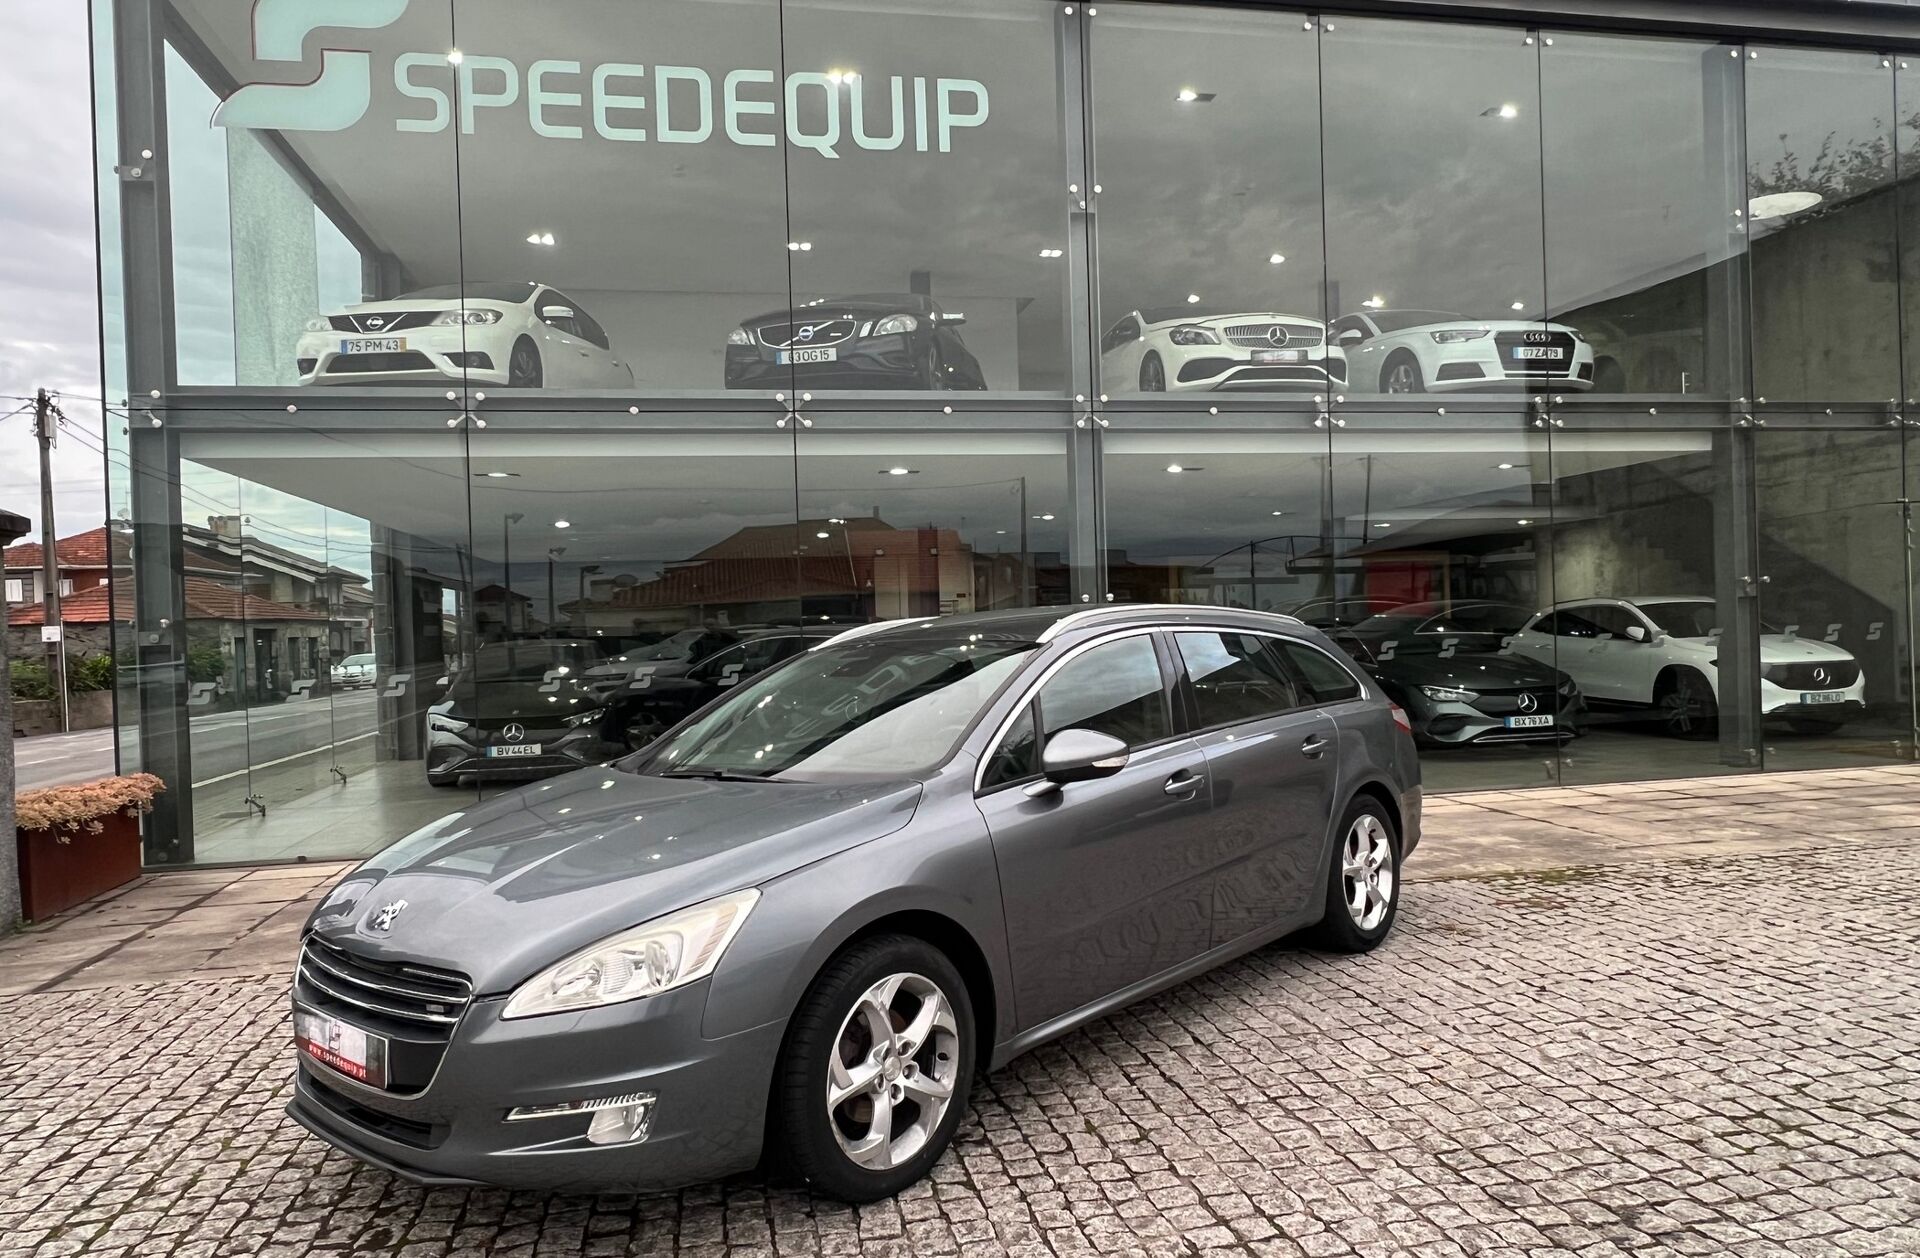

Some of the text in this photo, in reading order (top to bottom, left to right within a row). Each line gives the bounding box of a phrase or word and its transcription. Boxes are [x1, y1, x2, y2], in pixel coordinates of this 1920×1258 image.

[393, 51, 990, 160] SPEEDEQUIP
[348, 339, 399, 352] 75 PM 43
